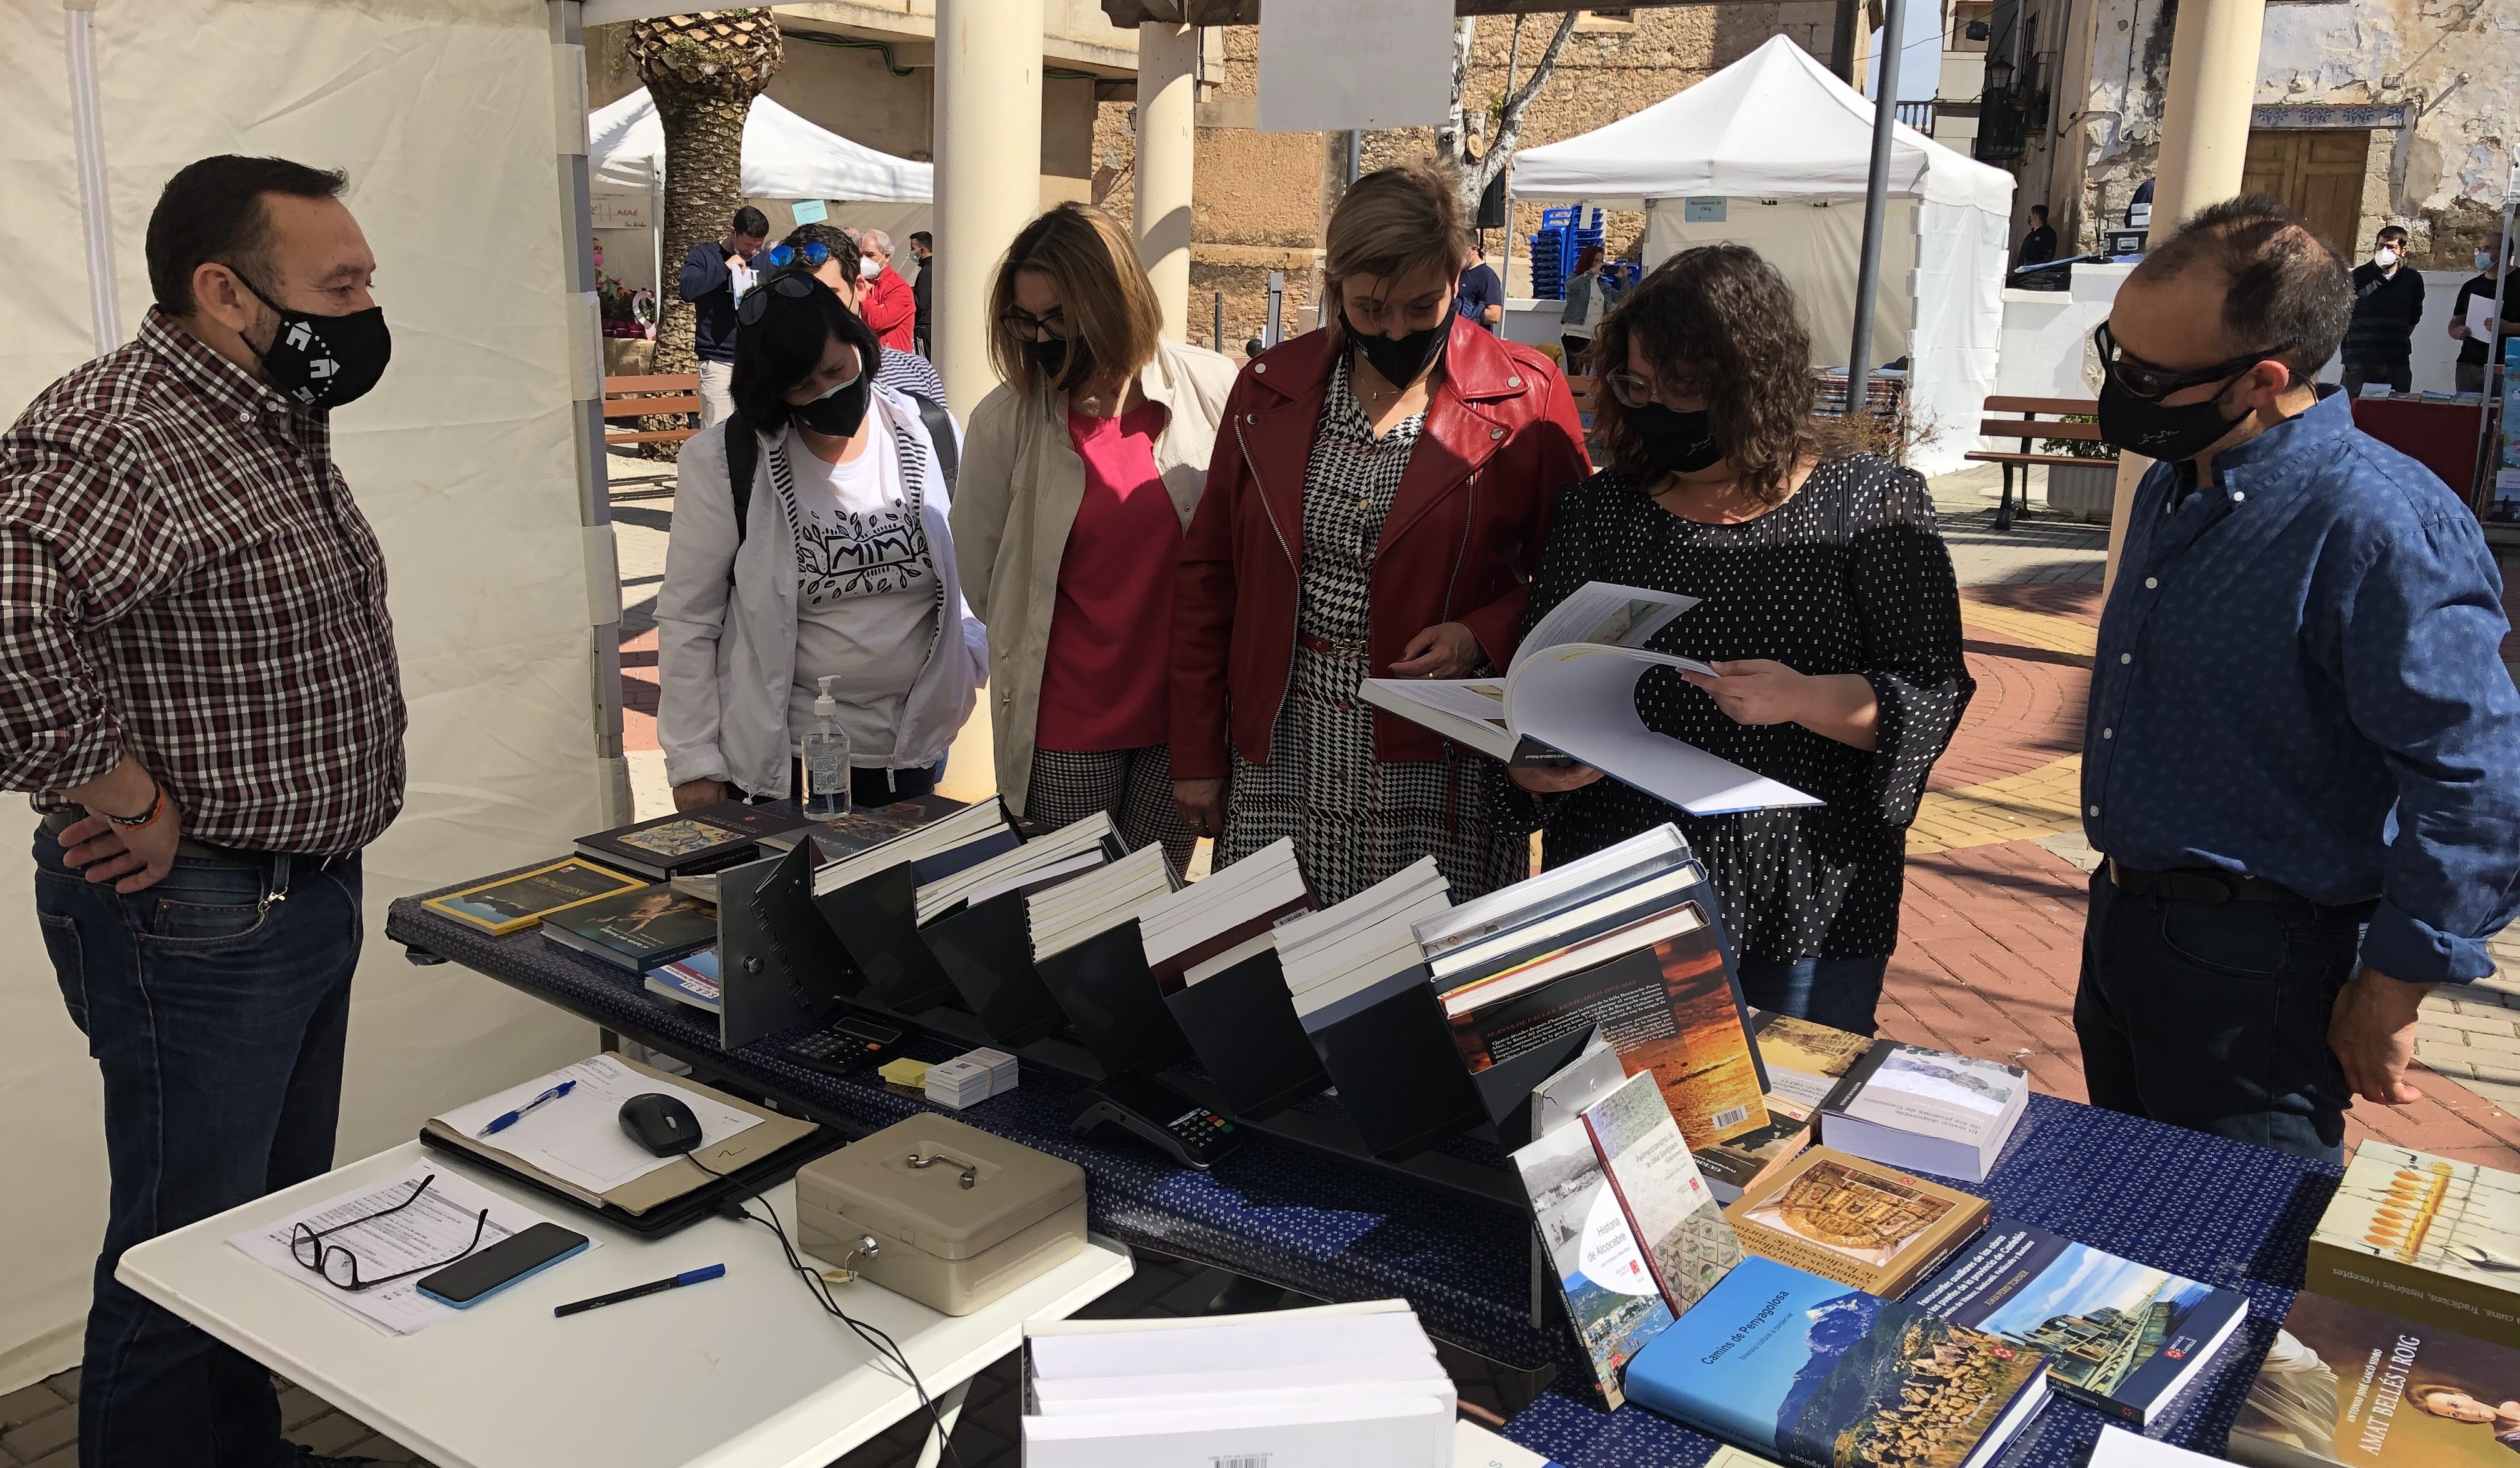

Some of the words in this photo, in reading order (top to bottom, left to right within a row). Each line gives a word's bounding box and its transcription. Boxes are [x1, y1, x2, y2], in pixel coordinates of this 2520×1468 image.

[1729, 1222, 1769, 1241] Tortos
[1774, 1239, 1790, 1249] de
[1596, 1232, 1627, 1257] Alcocebre
[1733, 1231, 1806, 1260] castellonens
[1974, 1253, 1984, 1264] de
[1988, 1234, 2008, 1251] obras
[1993, 1250, 2004, 1262] de
[1801, 1264, 1849, 1287] retablo
[1810, 1259, 1871, 1285] comarcas
[1861, 1270, 1878, 1280] de
[2332, 1268, 2374, 1284] receptes
[1738, 1290, 1790, 1334] Penyagolosa
[1731, 1331, 1746, 1344] de
[2389, 1331, 2422, 1369] ROIG
[1701, 1340, 1736, 1366] Camins
[2354, 1381, 2371, 1398] JOSÉ
[2366, 1368, 2409, 1419] BELLÉS
[2344, 1395, 2366, 1424] ANTONIO
[2356, 1415, 2392, 1456] AMAT
